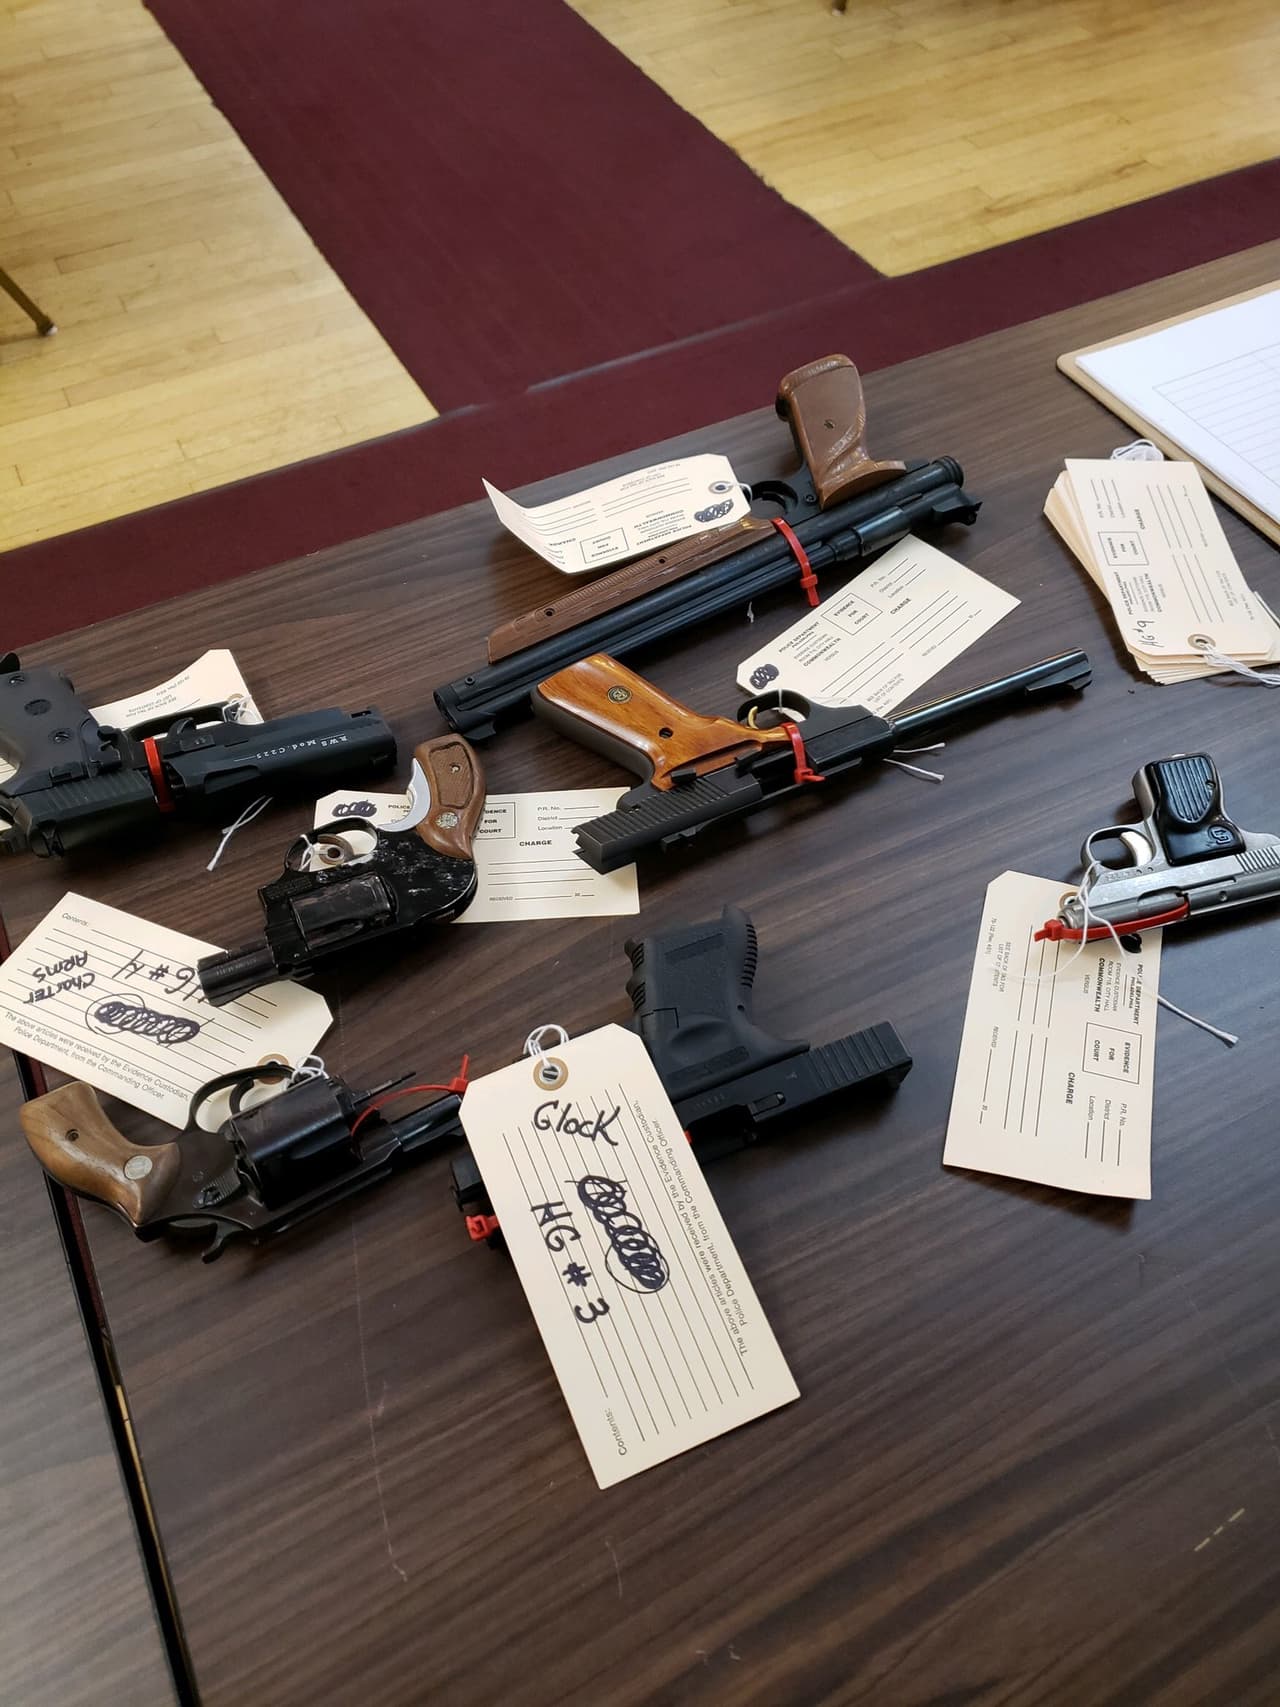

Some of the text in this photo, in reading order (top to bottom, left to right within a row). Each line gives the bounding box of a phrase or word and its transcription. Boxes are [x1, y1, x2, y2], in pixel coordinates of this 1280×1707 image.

[834, 600, 854, 616] EVIDENCE
[890, 598, 910, 614] CHARGE
[778, 621, 818, 652] POLICE DEPARTMENT
[803, 638, 840, 666] COMMONWEALTH
[112, 950, 144, 979] 4
[149, 965, 170, 980] #
[1094, 957, 1105, 1011] COMMONWEALTH
[1133, 986, 1141, 1024] DEPARTMENT
[14, 1027, 32, 1038] Police
[70, 1051, 85, 1061] from
[86, 1058, 96, 1066] the
[97, 1063, 140, 1088] Commanding
[16, 1018, 35, 1029] above
[35, 1026, 58, 1039] articles
[58, 1037, 73, 1046] were
[74, 1043, 101, 1058] received
[101, 1055, 110, 1063] by
[110, 1059, 121, 1067] the
[122, 1064, 152, 1082] Evidence
[1065, 1072, 1074, 1103] CHARGE
[1087, 1095, 1095, 1120] Location
[1103, 1099, 1111, 1119] District
[665, 1147, 692, 1203] Commanding
[633, 1100, 747, 1355] The above articles were received by the Evidence Custodian,
[690, 1205, 700, 1219] the
[697, 1220, 709, 1240] from
[530, 1201, 609, 1324] HG # 3
[707, 1242, 734, 1296] Department,
[732, 1298, 747, 1325] Police
[605, 1408, 627, 1455] Contents:
